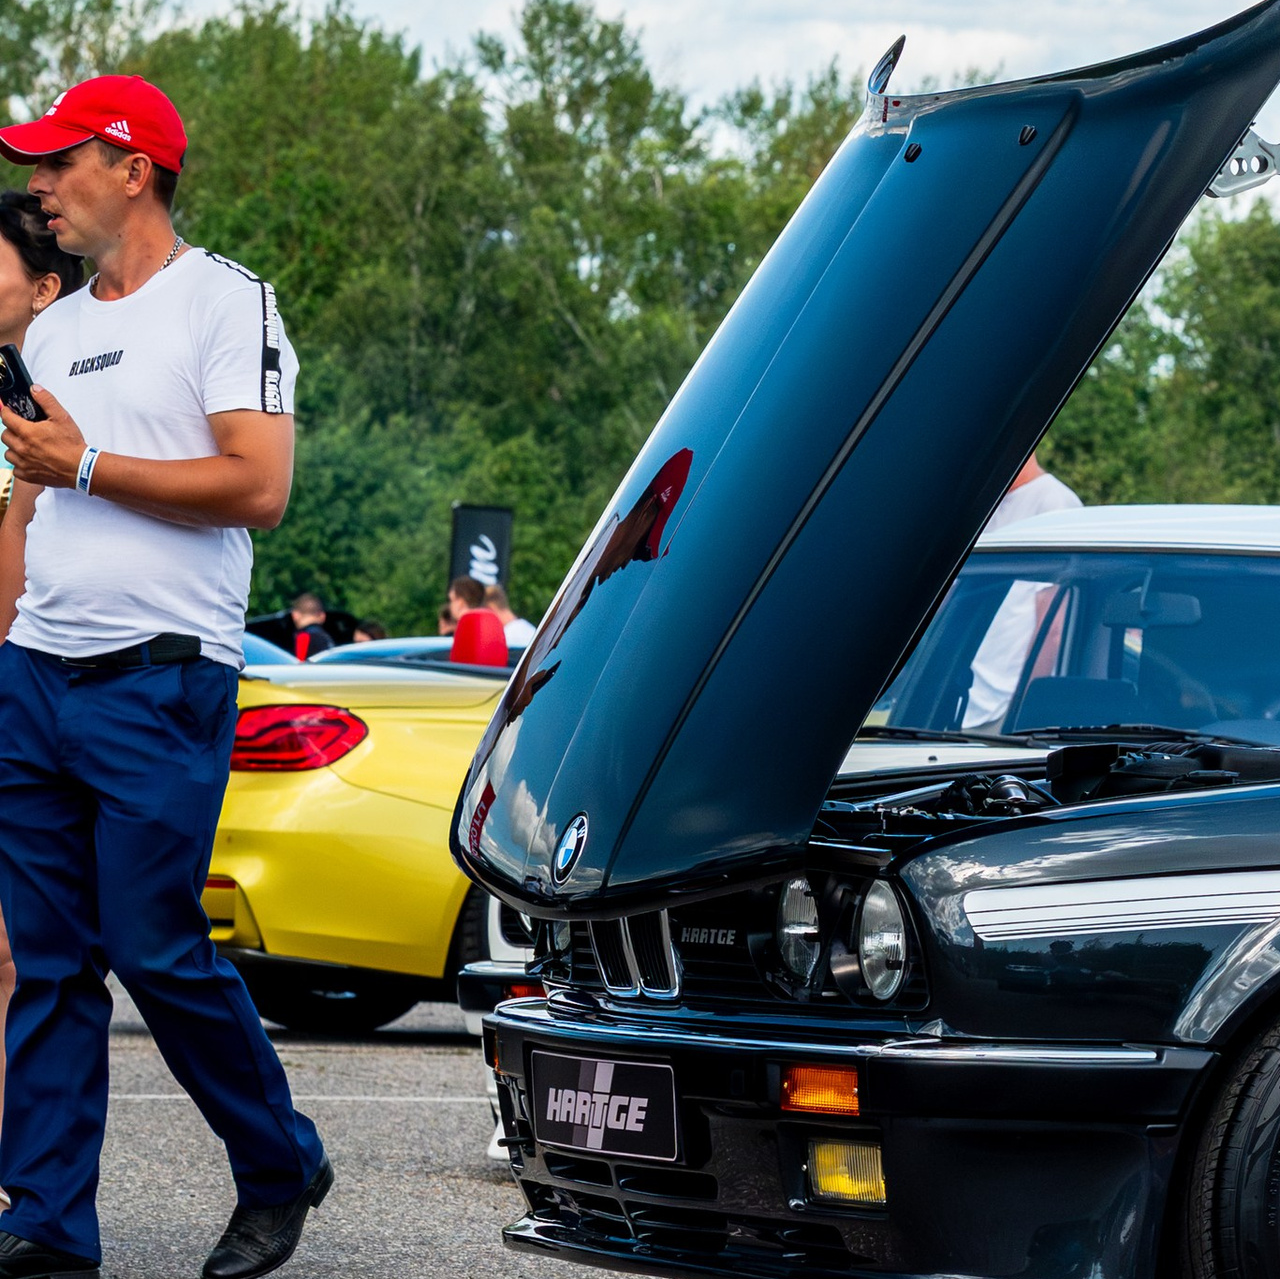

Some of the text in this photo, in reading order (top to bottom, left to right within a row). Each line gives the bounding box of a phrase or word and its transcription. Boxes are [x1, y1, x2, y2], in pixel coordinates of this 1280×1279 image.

[105, 127, 131, 142] adidas
[69, 349, 124, 377] BLACKSQUAD
[681, 927, 736, 945] HARTGE
[546, 1087, 649, 1132] HARTGE
